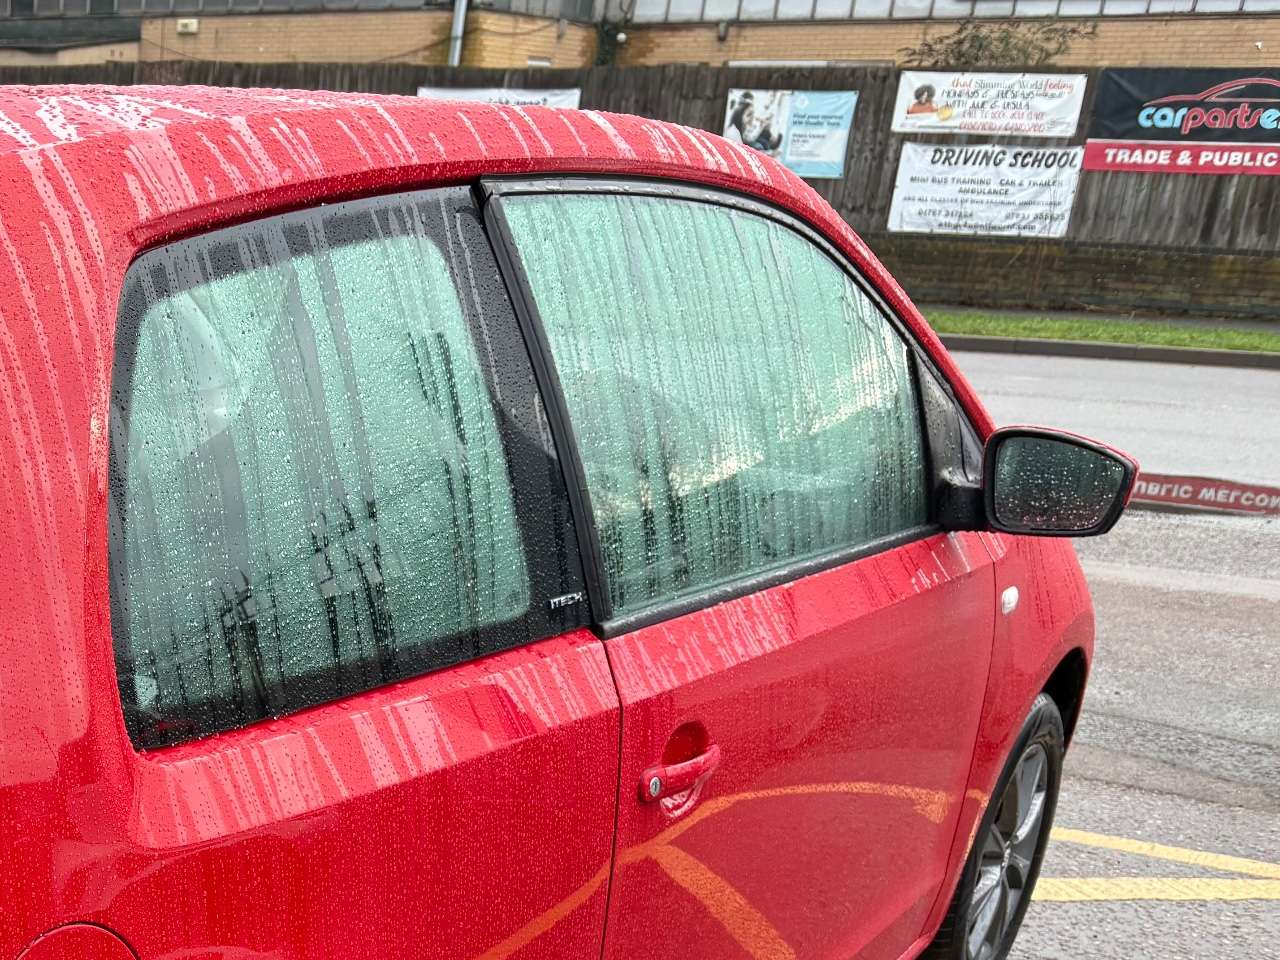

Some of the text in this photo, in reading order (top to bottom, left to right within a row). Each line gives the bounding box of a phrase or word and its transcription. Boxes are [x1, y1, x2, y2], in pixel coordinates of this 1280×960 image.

[1137, 103, 1280, 135] carpartse
[930, 149, 1079, 168] DRIVING SCHOOL
[1104, 148, 1279, 167] TRADE & PUBLIC
[931, 176, 948, 184] BUS
[951, 177, 991, 186] TRAINING
[999, 178, 1016, 187] CAR
[958, 187, 1009, 196] AMBULANCE
